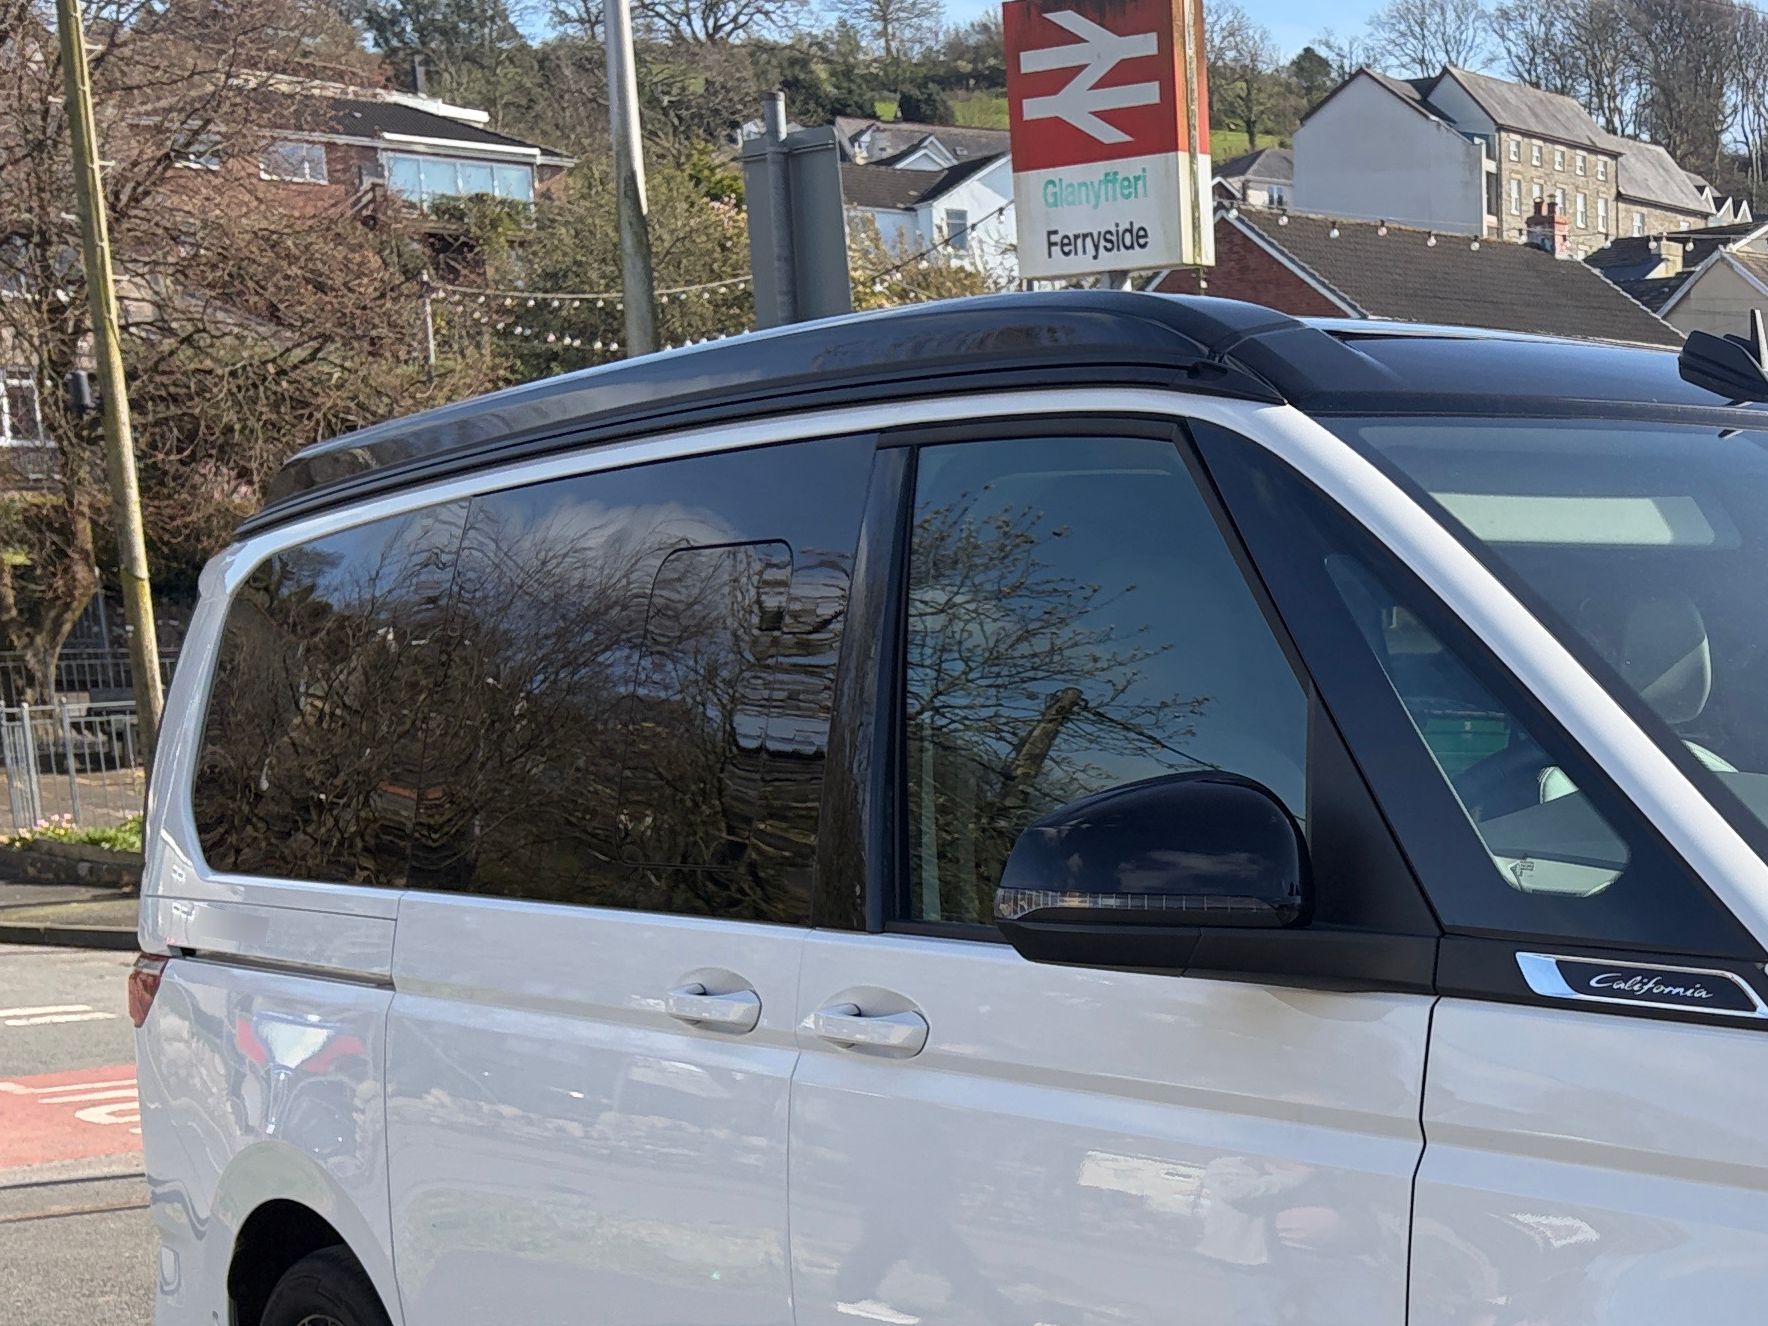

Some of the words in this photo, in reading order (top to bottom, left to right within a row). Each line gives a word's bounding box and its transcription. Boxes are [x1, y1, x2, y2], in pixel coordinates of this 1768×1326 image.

[1043, 167, 1148, 210] Glanyfferi
[1046, 221, 1149, 260] Ferryside
[1589, 972, 1713, 999] California
